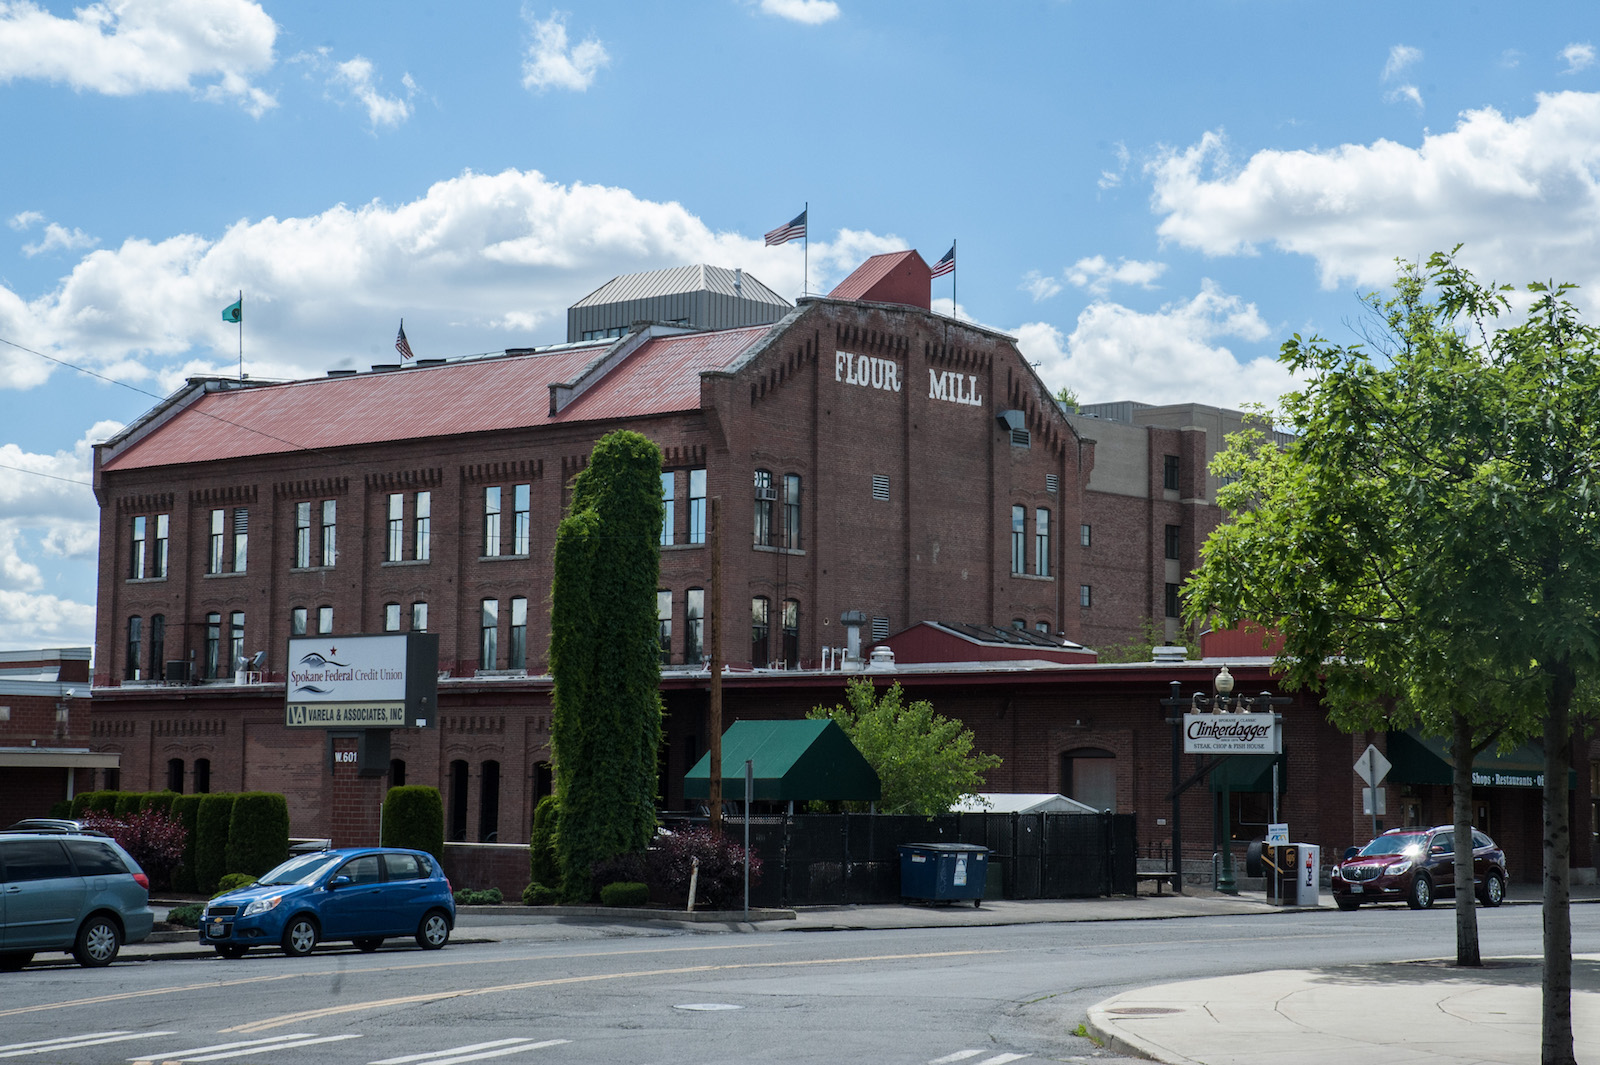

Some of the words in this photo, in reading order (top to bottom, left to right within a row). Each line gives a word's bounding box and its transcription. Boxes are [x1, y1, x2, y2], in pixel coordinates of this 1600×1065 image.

[835, 350, 902, 392] FLOUR
[928, 368, 982, 407] MILL
[291, 670, 323, 686] Spokane
[325, 669, 353, 681] Federal
[355, 669, 378, 681] Credit
[380, 668, 403, 680] Union
[308, 709, 334, 722] VARELA
[336, 709, 341, 721] &
[343, 708, 388, 723] ASSOCIATES,
[390, 708, 403, 721] INC
[1187, 721, 1271, 742] Clinkerdagger
[335, 752, 357, 762] W.601
[1472, 772, 1491, 786] Shops
[1495, 773, 1533, 786] Restaurants
